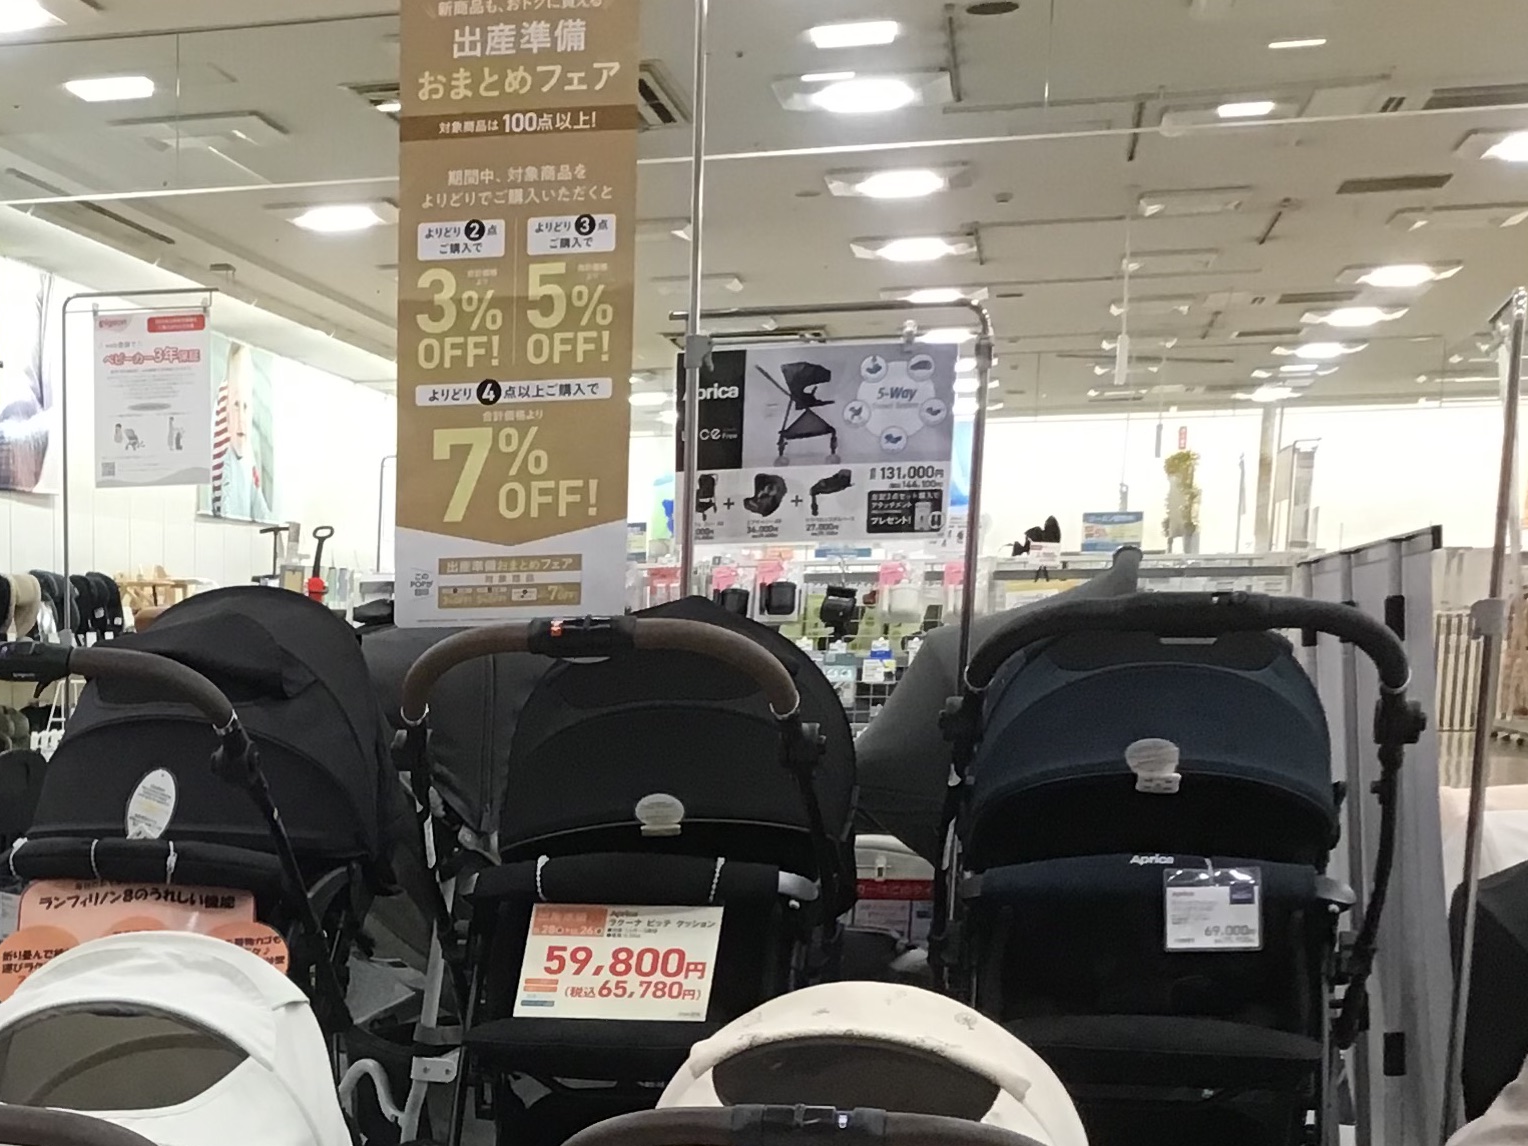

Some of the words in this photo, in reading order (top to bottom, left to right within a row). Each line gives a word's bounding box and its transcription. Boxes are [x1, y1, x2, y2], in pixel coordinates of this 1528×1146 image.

[452, 18, 587, 58] 出産準備
[418, 61, 621, 101] おまとめフェア
[447, 163, 587, 187] 期間中、対象商品を
[421, 185, 614, 209] よりどりでご購入いただくと
[439, 242, 483, 255] ご購入で
[549, 237, 594, 250] ご購入で
[102, 347, 201, 367] ベビーカー3年保証
[417, 335, 500, 370] OFF!
[526, 330, 610, 365] OFF!
[683, 383, 740, 402] prica
[876, 386, 918, 402] 5-Way
[498, 479, 599, 520] OFF!
[871, 515, 912, 525] プレゼント!
[1129, 853, 1174, 866] Aprica
[608, 918, 642, 928] ラクーナ
[543, 945, 707, 980] 59,800円
